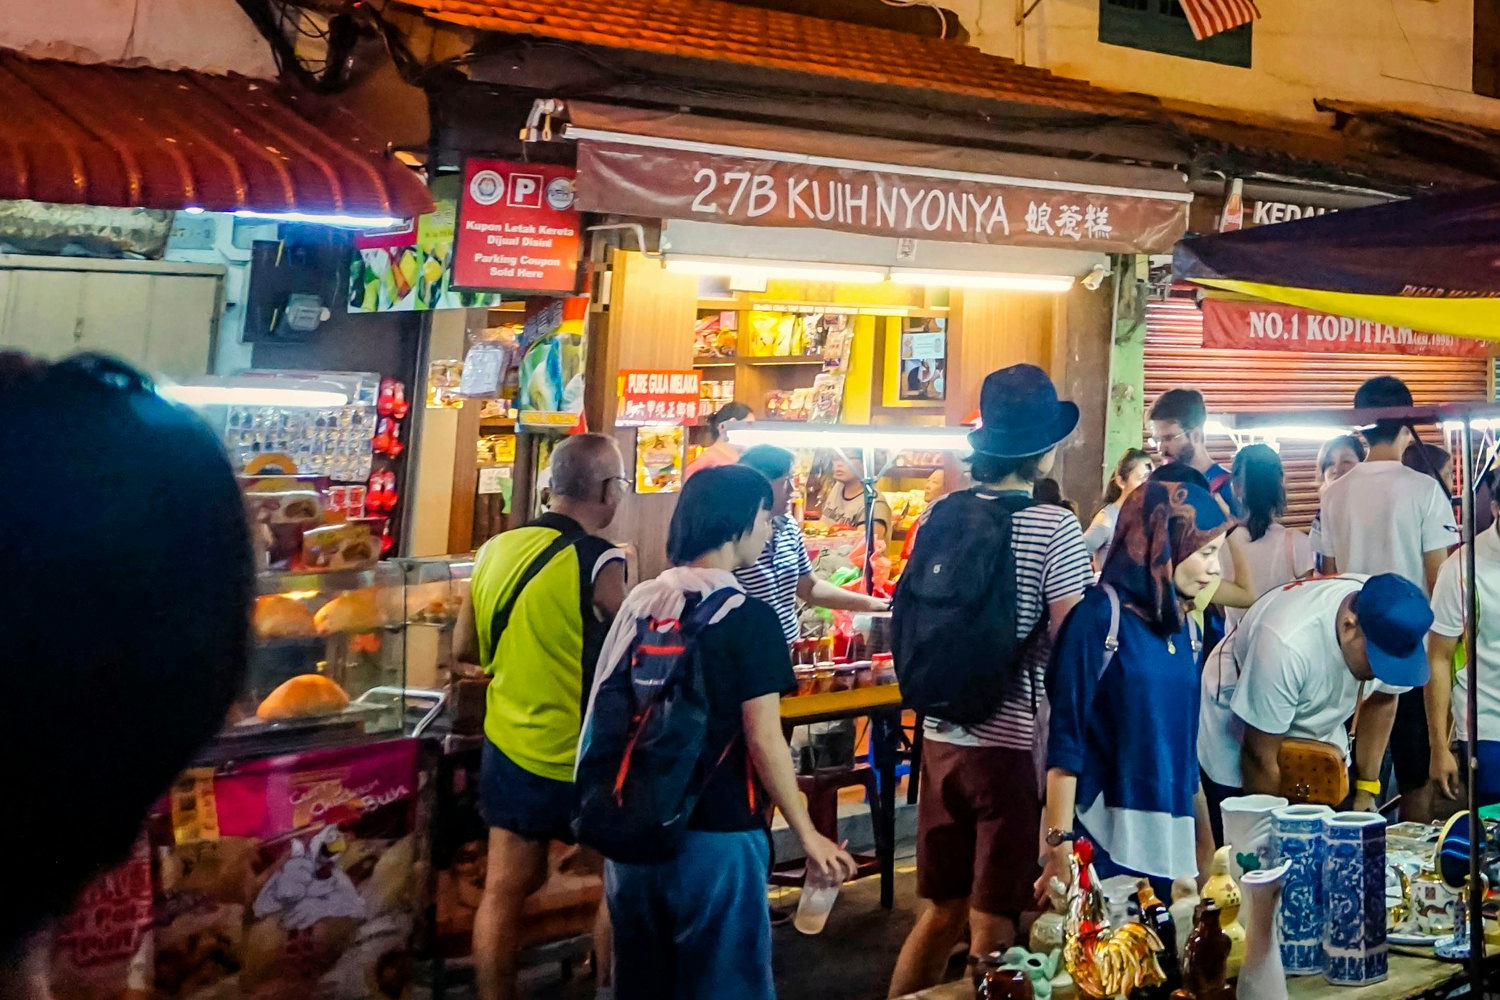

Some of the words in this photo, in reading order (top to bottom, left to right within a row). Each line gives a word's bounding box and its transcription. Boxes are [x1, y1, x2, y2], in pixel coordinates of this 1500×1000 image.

[514, 178, 536, 203] P
[691, 168, 777, 217] 27B
[787, 177, 869, 225] KUIH
[876, 186, 1010, 235] NYONYA
[466, 220, 502, 232] Kupon
[505, 223, 536, 234] Letak
[538, 226, 575, 236] Kereta
[1024, 200, 1112, 242] 娘惹糕
[487, 235, 519, 246] Dijual
[522, 237, 553, 247] Disini
[474, 253, 517, 266] Parking
[520, 256, 561, 267] Coupon
[490, 267, 515, 276] Sold
[517, 268, 544, 278] Here
[1250, 312, 1298, 340] NO.1
[1307, 314, 1413, 345] KOPITIAM
[628, 373, 648, 394] PURE
[649, 373, 669, 394] GULA
[669, 373, 698, 394] MELAKA
